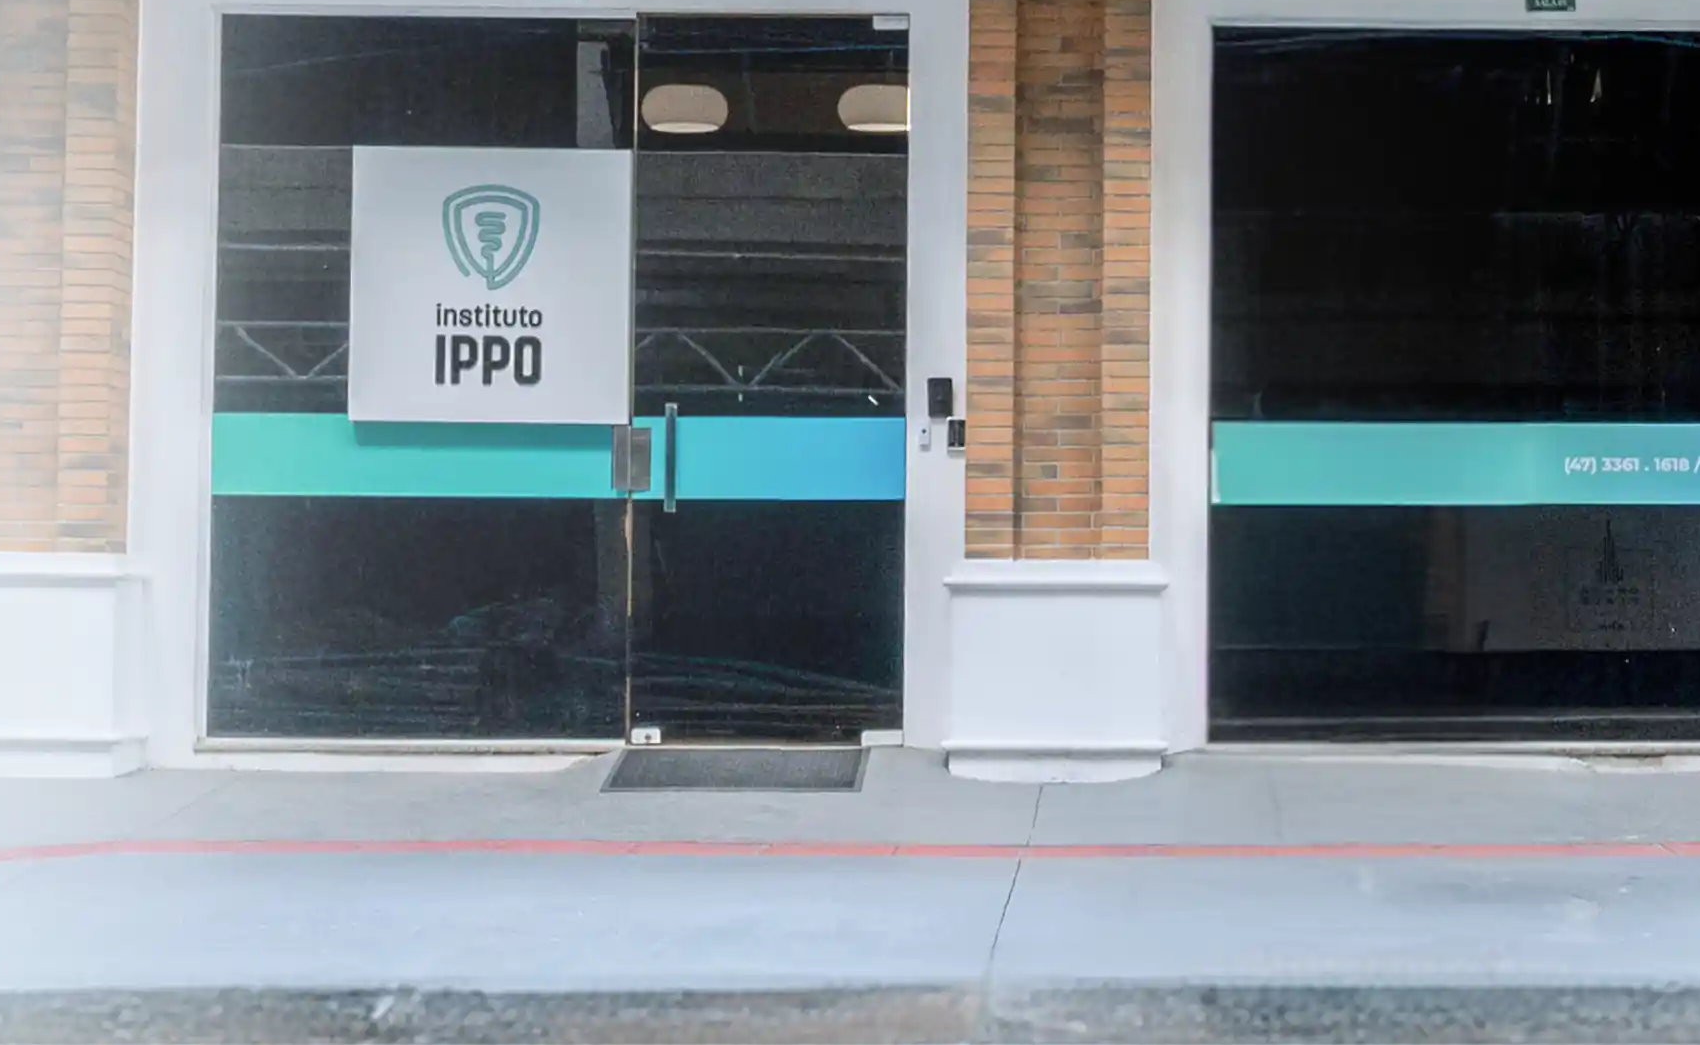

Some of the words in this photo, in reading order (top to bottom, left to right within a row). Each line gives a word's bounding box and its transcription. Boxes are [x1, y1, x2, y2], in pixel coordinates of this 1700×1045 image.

[436, 303, 543, 328] instituto
[435, 334, 542, 386] IPPO
[1565, 456, 1597, 475] (47)
[1601, 457, 1639, 472] 3361
[1653, 457, 1690, 472] 1618
